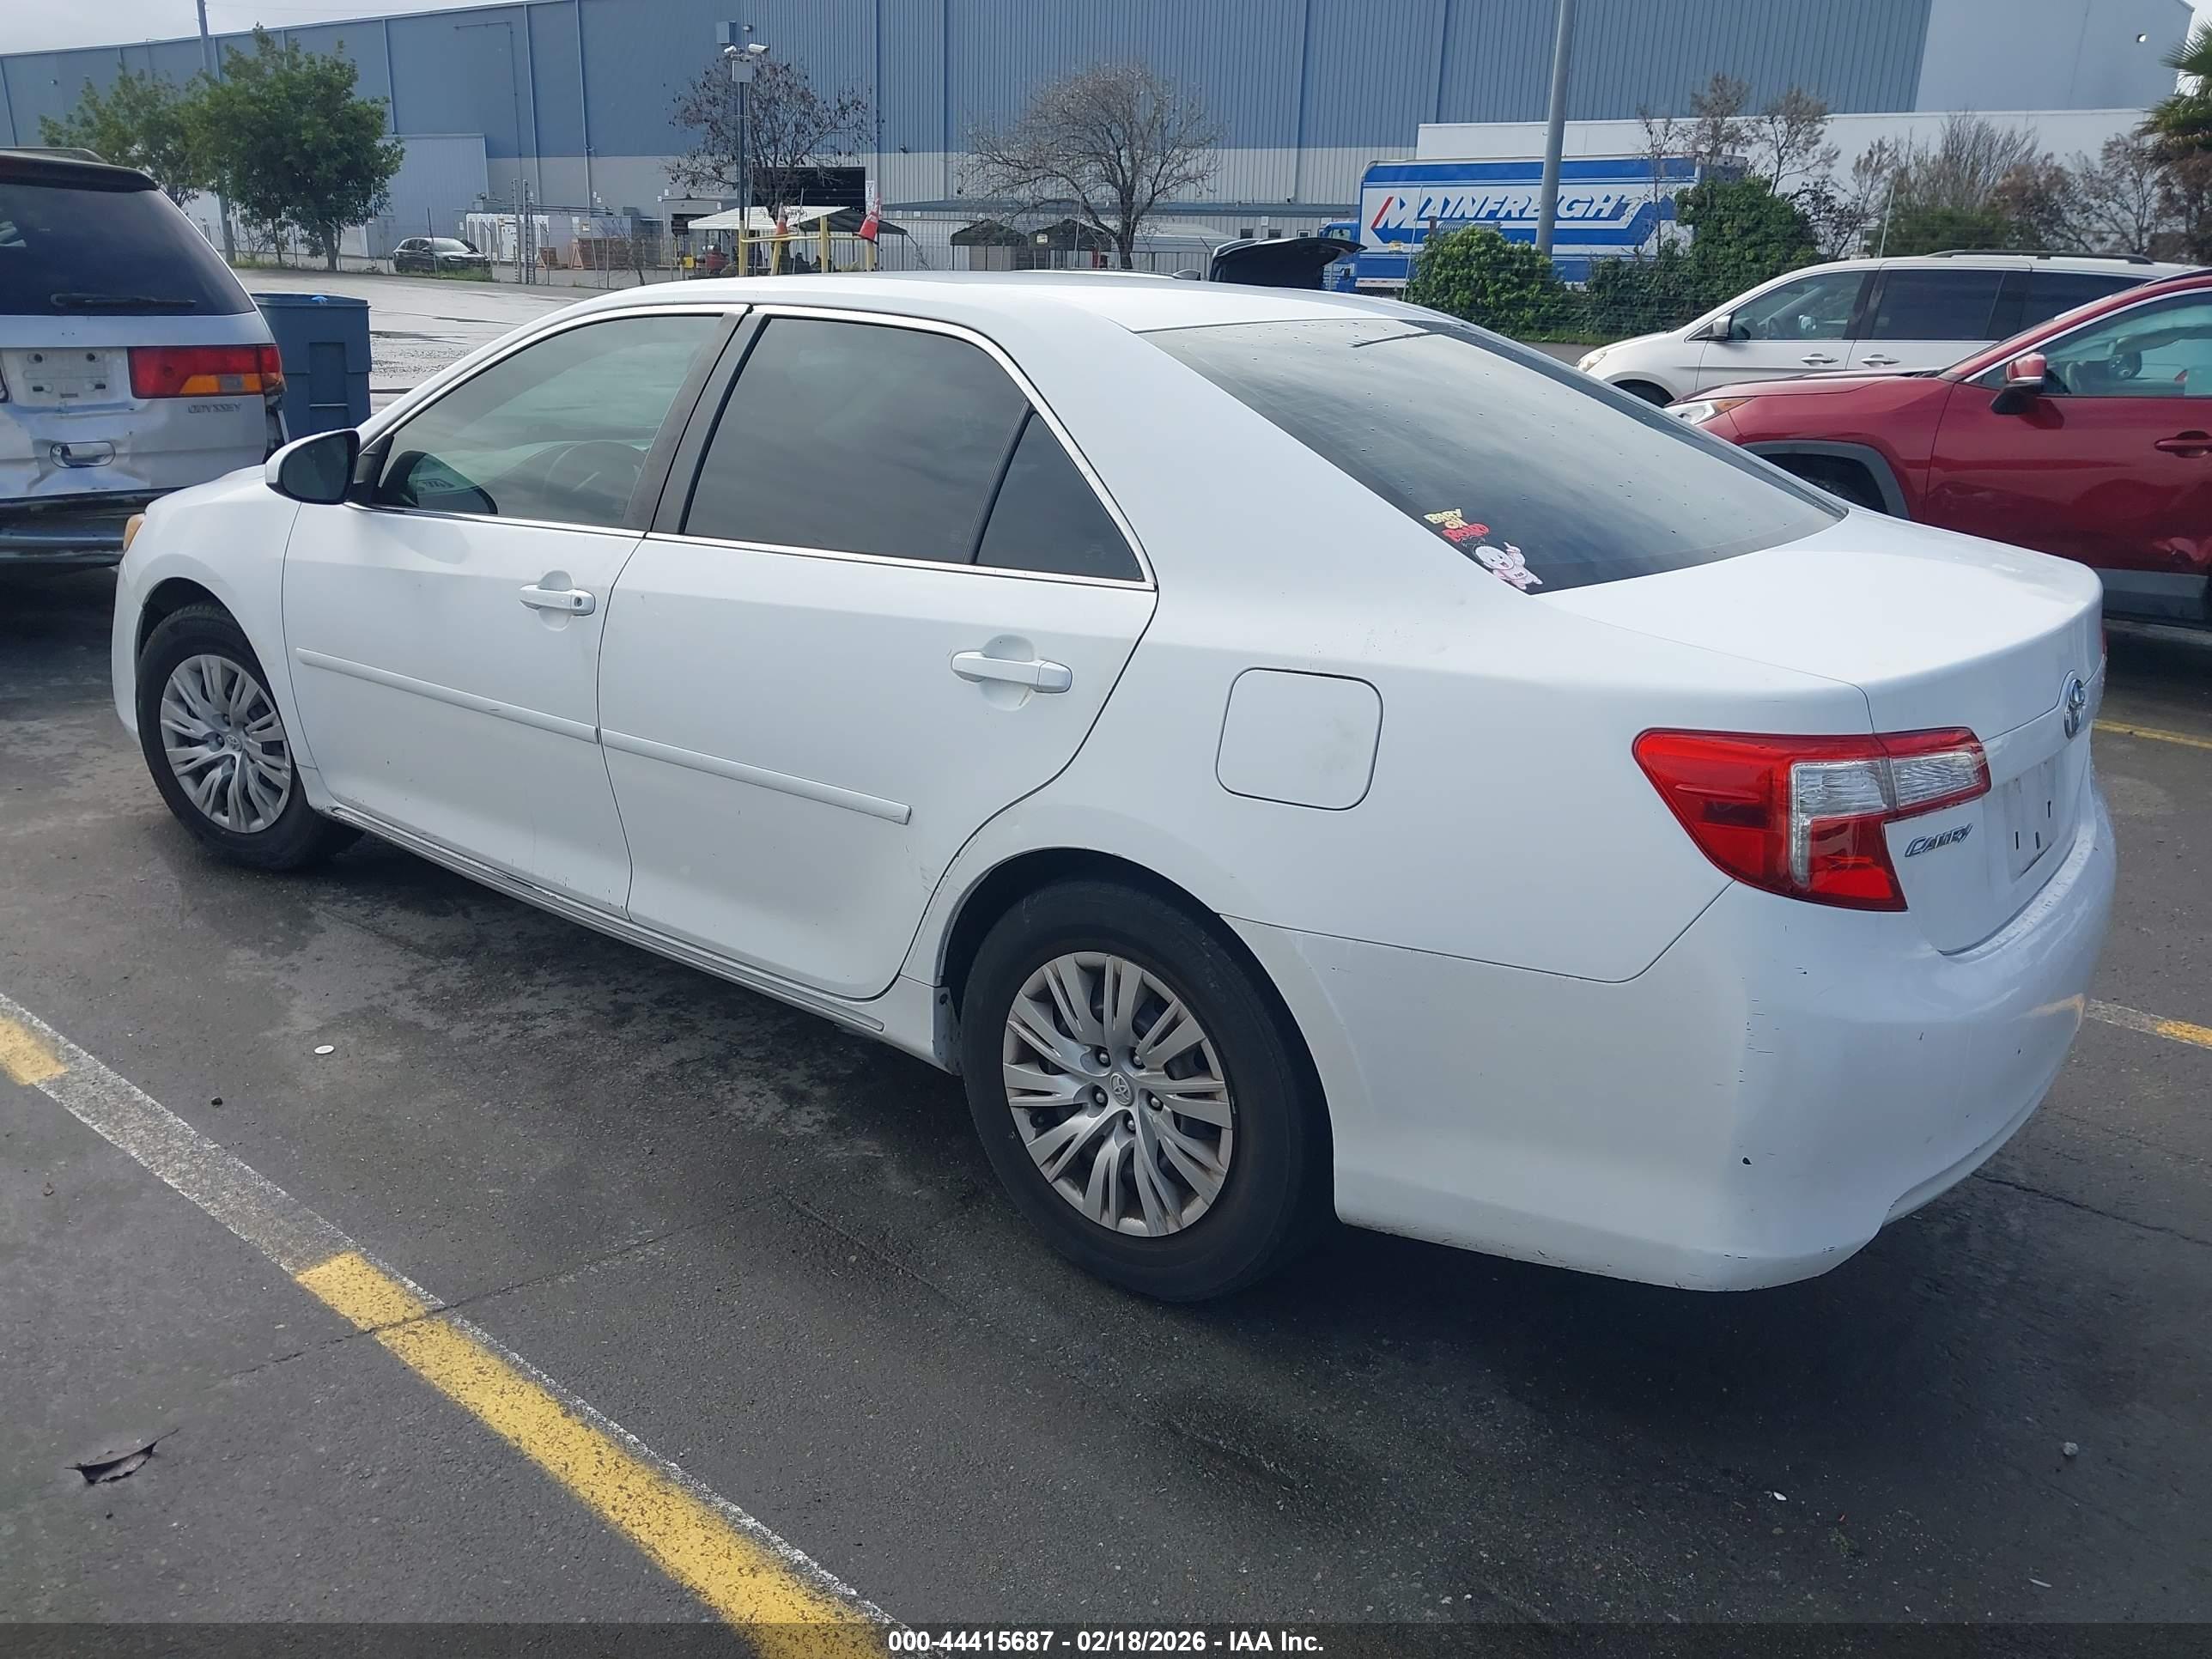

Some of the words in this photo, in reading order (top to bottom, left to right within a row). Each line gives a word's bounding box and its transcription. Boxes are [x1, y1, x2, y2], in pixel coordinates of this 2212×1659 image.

[1371, 194, 1651, 229] MAINFREGHT
[1423, 508, 1463, 525] BABY
[1905, 823, 1973, 858] CAMRY
